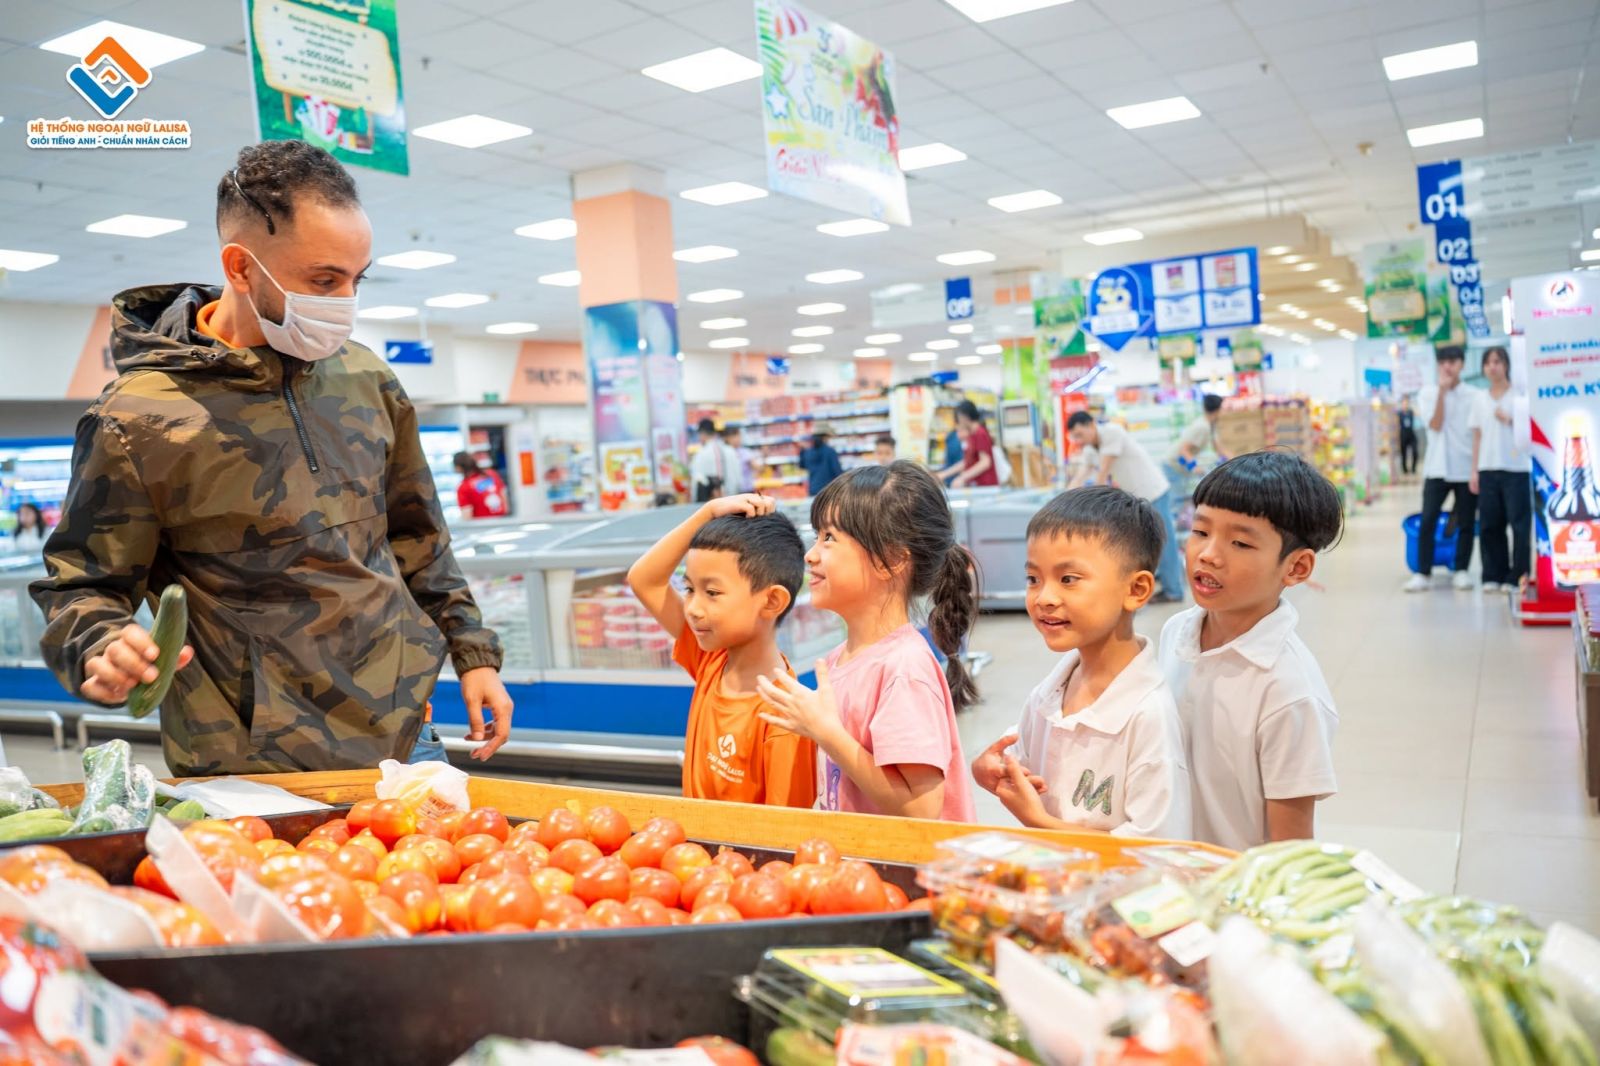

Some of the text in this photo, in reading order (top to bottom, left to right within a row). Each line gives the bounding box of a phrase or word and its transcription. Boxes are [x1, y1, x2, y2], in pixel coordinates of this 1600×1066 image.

[1425, 192, 1457, 221] 01
[1438, 237, 1469, 261] 02
[1452, 263, 1478, 285] 03
[1538, 384, 1579, 399] HOA
[1072, 768, 1115, 817] M
